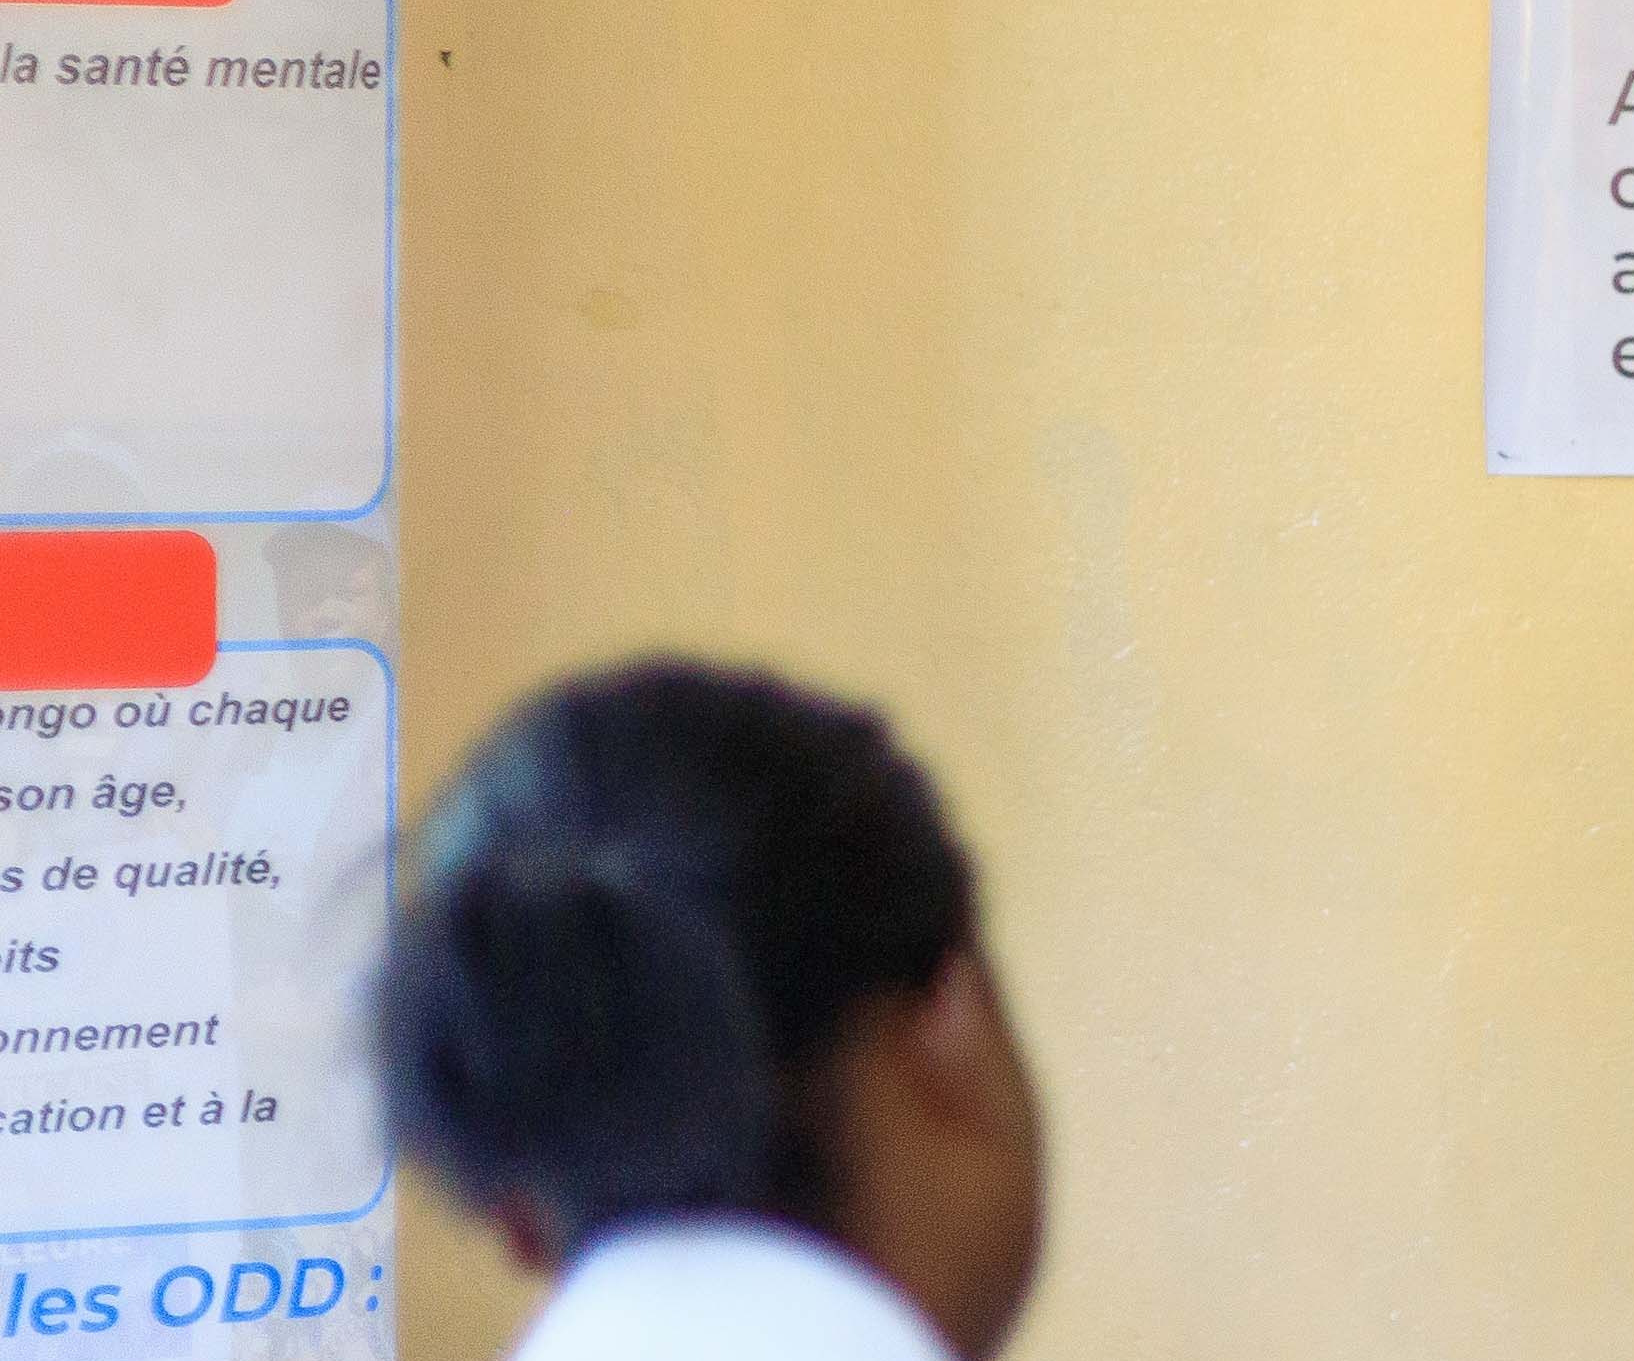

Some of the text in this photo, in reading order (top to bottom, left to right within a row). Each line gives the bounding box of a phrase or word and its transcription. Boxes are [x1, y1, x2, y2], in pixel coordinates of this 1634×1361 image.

[55, 45, 191, 87] santé
[205, 49, 381, 90] mentale
[0, 691, 351, 739] ngo où chaque
[92, 774, 188, 817] âge,
[42, 855, 99, 894] de
[115, 849, 282, 897] qualité,
[0, 939, 60, 974] its
[0, 1088, 279, 1135] ation et à la
[1, 1272, 121, 1339] les
[150, 1256, 347, 1329] ODD
